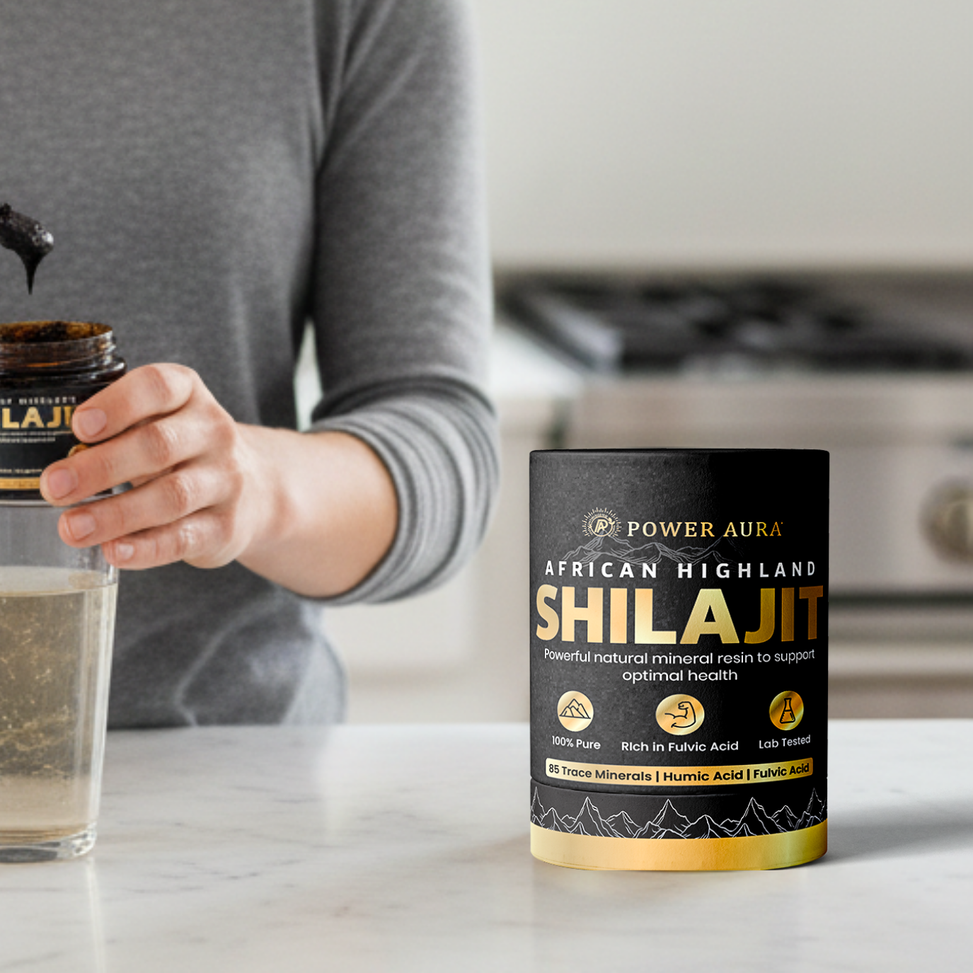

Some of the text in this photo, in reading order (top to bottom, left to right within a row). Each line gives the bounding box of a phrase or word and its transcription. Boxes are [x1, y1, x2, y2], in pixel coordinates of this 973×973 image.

[627, 521, 715, 538] POWER
[545, 560, 816, 579] AFRICAN HIGHLAND
[536, 583, 824, 645] SHILAJIT
[544, 648, 816, 665] Powerful natural mineral resin to support
[622, 669, 738, 685] optimal health
[552, 735, 601, 750] 100% Pure
[652, 741, 665, 752] in
[668, 741, 707, 752] Fulvic
[710, 741, 739, 752] Acid
[758, 734, 811, 749] Lab Tested
[548, 763, 560, 774] 85
[562, 766, 593, 777] Trace
[595, 769, 652, 781] Minerals
[663, 771, 710, 782] Humic
[713, 770, 743, 781] Acid
[753, 766, 787, 779] Fulvic
[789, 763, 810, 776] Acid
